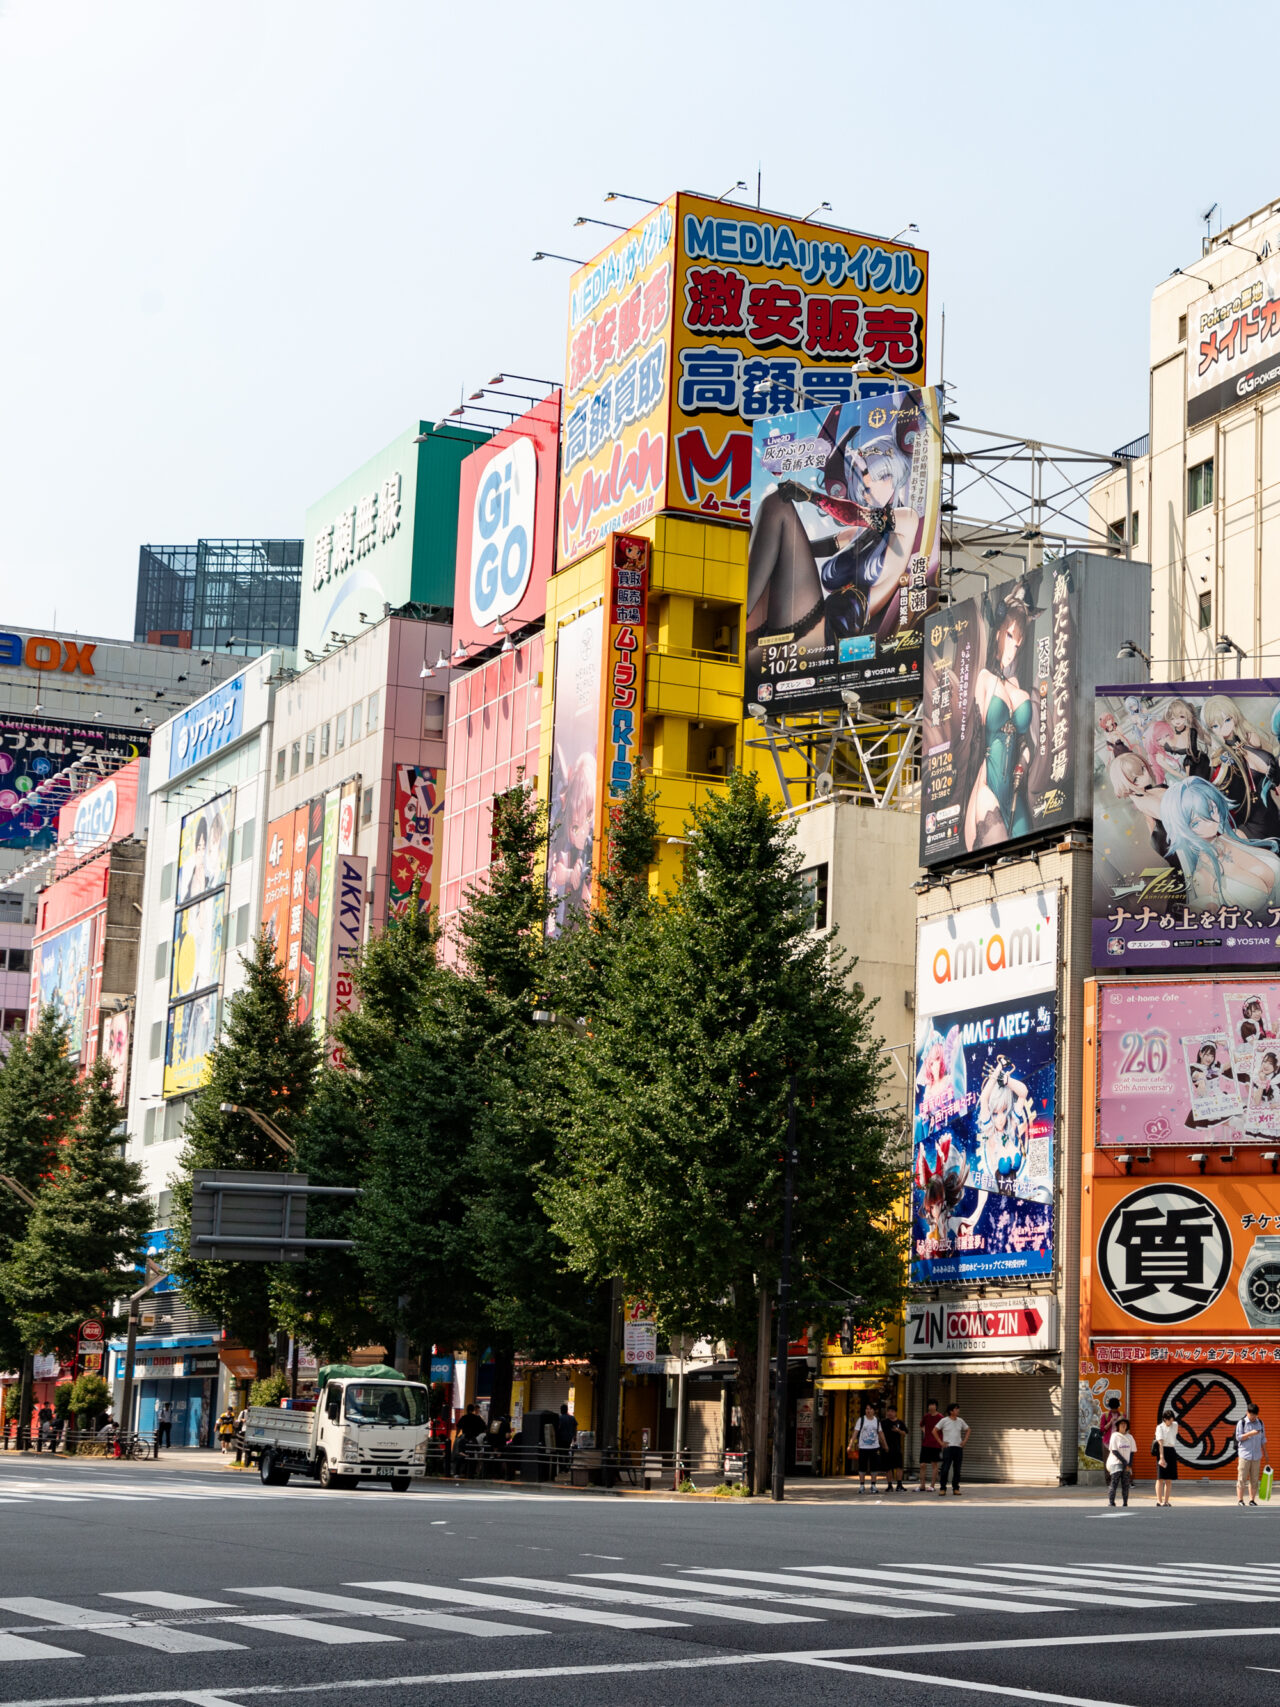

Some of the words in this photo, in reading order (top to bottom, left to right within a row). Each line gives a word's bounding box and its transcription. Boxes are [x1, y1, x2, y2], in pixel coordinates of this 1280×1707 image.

[684, 213, 924, 294] MEDIAリサイクル
[685, 267, 921, 370] 激安販売
[617, 571, 642, 588] 買取
[617, 588, 641, 606] 販売
[616, 606, 641, 624] 市場
[768, 643, 798, 661] 9/12
[612, 626, 638, 709] ムーラン
[768, 658, 798, 676] 10/2
[870, 667, 896, 677] YOSTAR
[190, 696, 236, 748] ソフマップ
[73, 729, 105, 740] PARK
[268, 832, 284, 867] 4F
[339, 859, 363, 942] AKKY
[1236, 938, 1271, 946] YOSTAR
[932, 923, 1041, 986] amiami
[949, 1313, 995, 1337] COMIC
[998, 1312, 1019, 1335] ZIN
[947, 1339, 987, 1350] Akihabara
[1097, 1346, 1146, 1361] 高価買取
